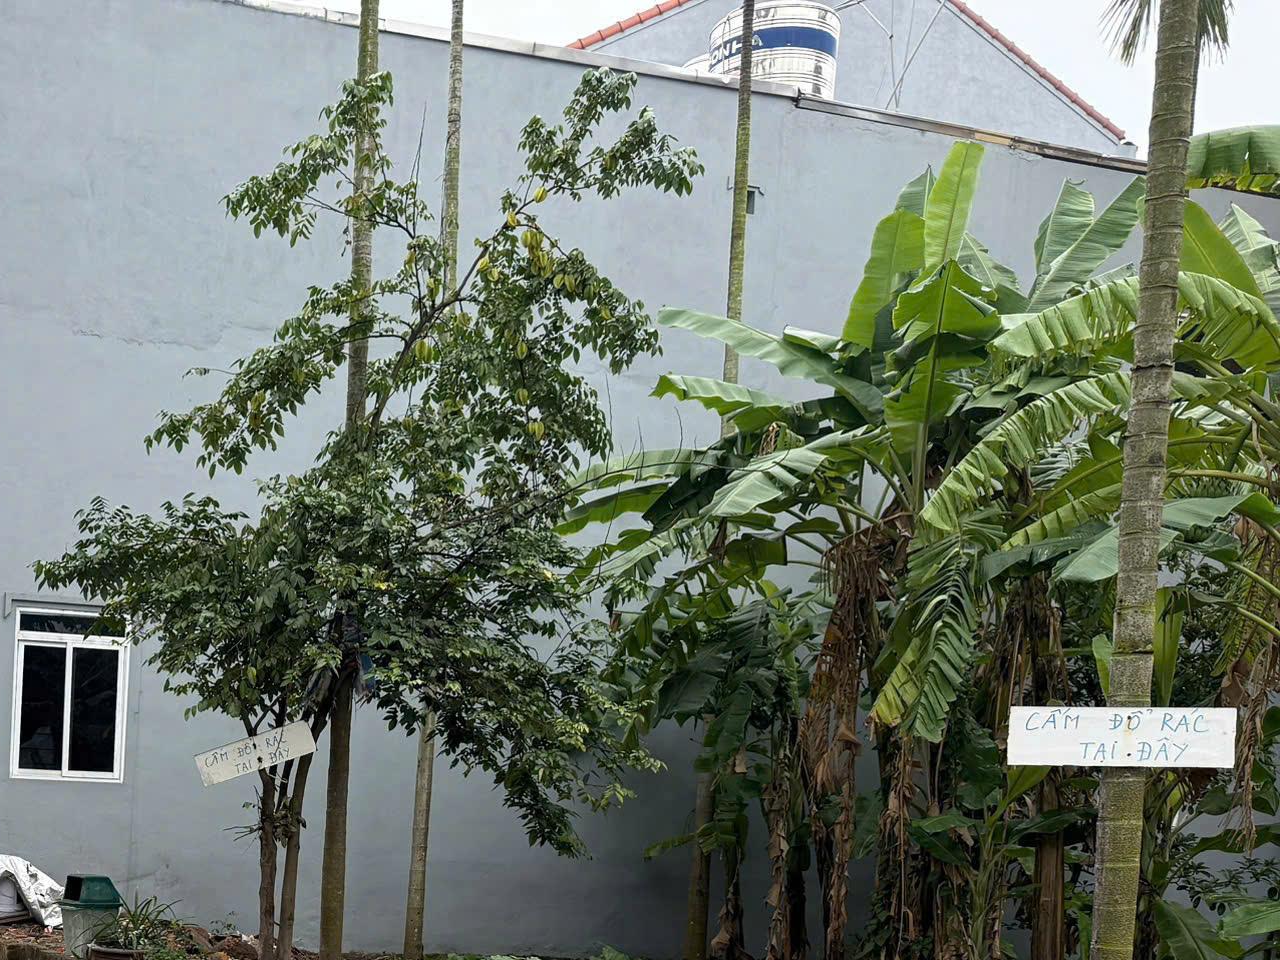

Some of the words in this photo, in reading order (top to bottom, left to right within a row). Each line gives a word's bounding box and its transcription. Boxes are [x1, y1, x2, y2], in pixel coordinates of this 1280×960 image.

[1025, 708, 1080, 731] CẤM
[1108, 709, 1153, 731] ĐỔ
[1160, 707, 1209, 733] RÁC
[1137, 737, 1189, 762] ĐÂY
